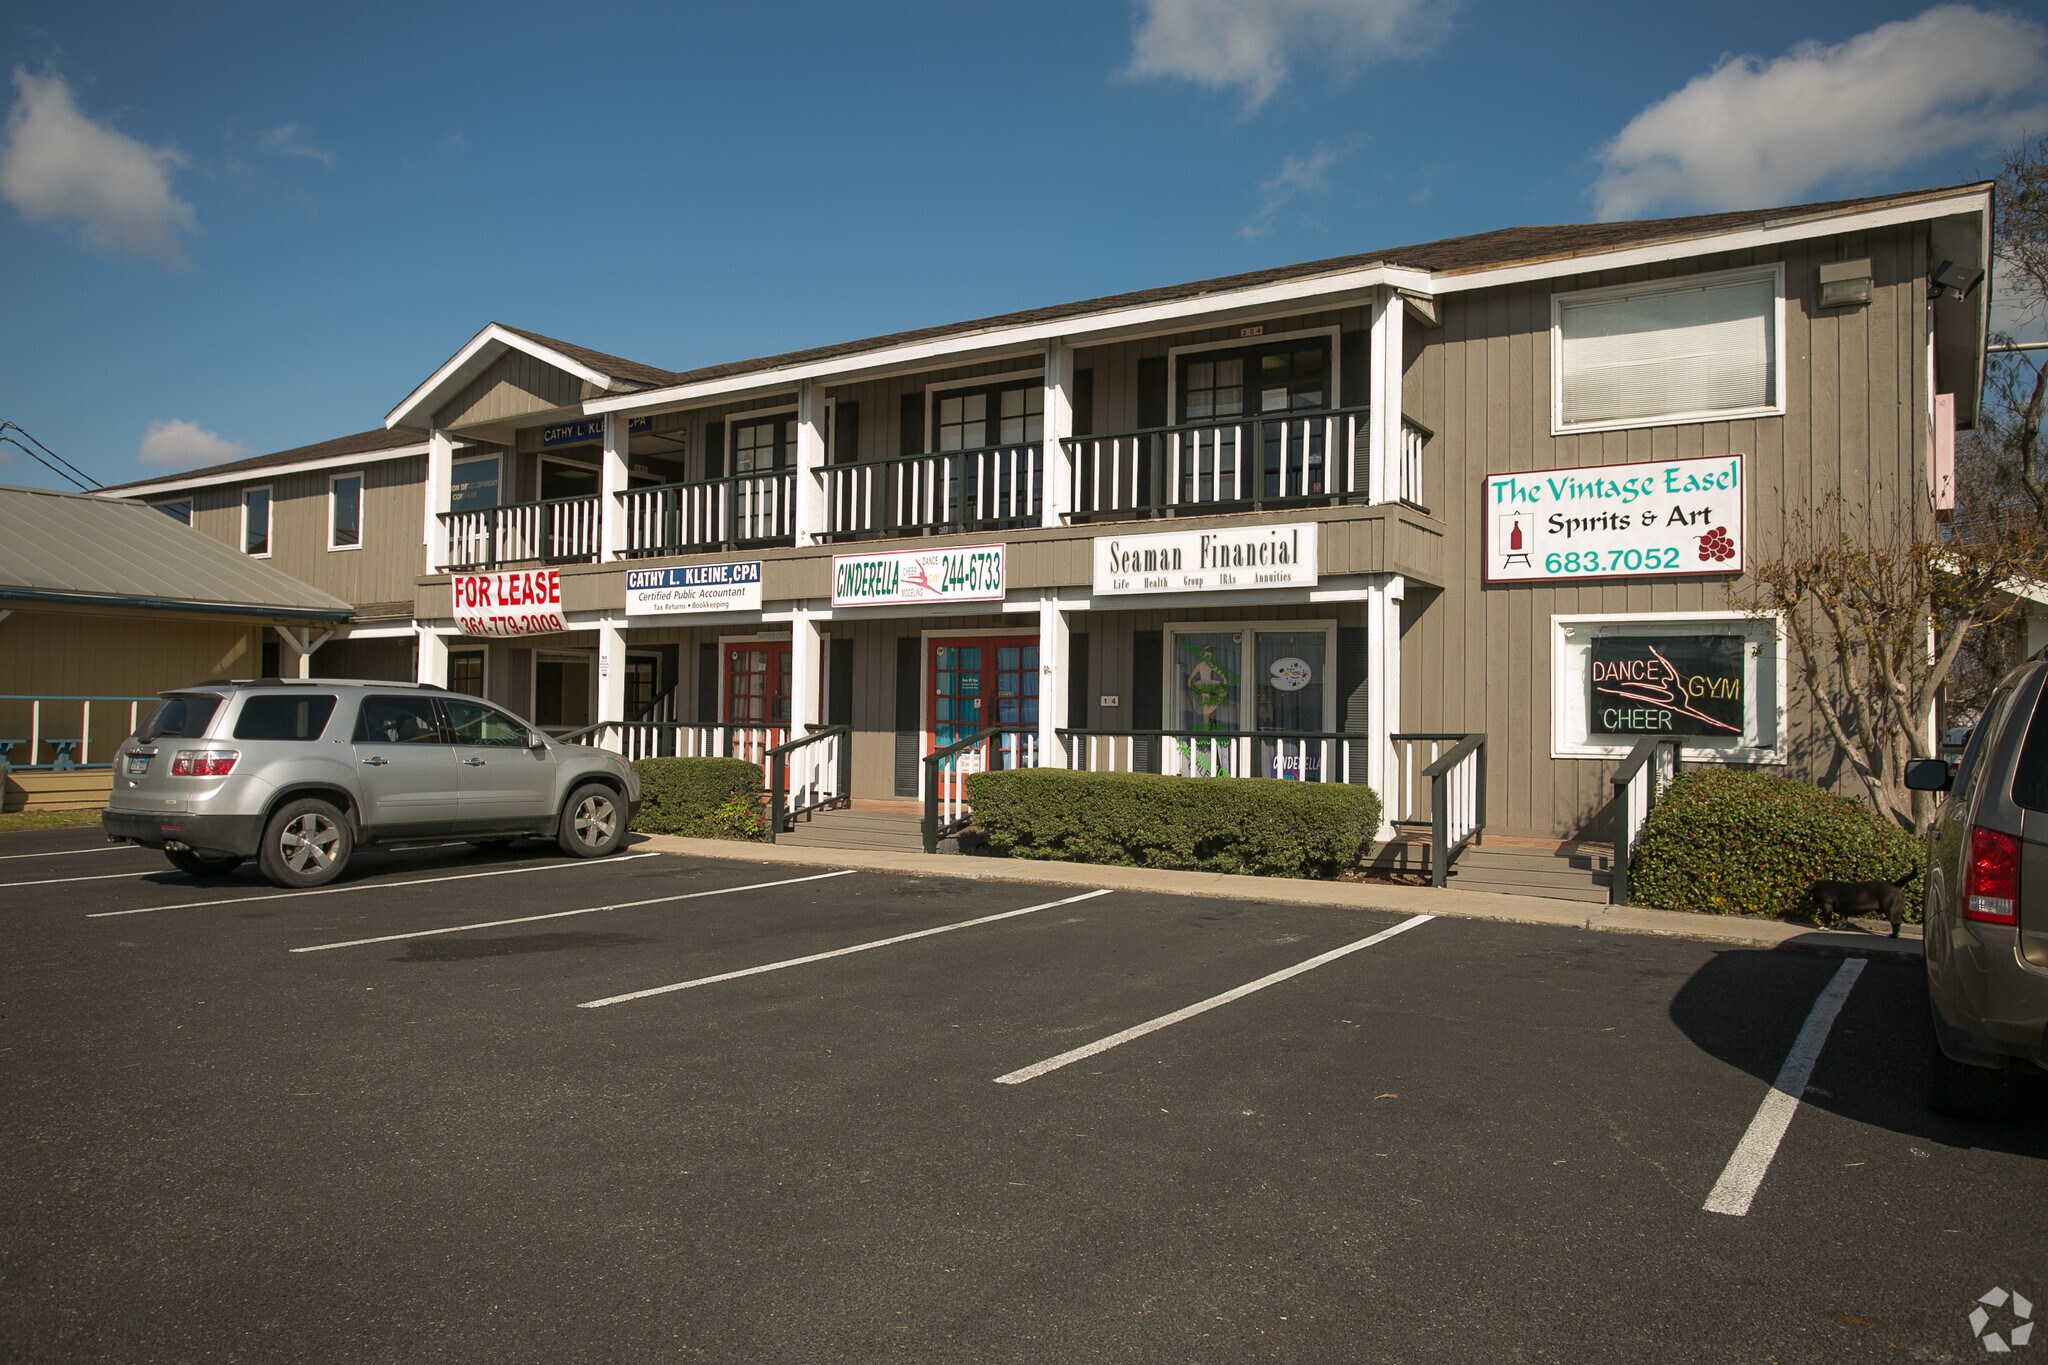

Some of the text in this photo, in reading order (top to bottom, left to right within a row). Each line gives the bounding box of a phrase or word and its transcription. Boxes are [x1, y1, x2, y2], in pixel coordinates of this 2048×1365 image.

[1242, 327, 1262, 336] 204
[544, 425, 573, 442] CATHY
[1490, 460, 1738, 505] The Vintage Easel
[1548, 505, 1713, 539] Spirits & Art
[922, 556, 939, 566] DANCE
[1109, 529, 1299, 574] Seaman Financial
[1545, 547, 1680, 574] 683.7052
[629, 570, 666, 588] CATHY
[669, 570, 680, 585] L.
[836, 560, 900, 598] CINDERELLA
[903, 567, 917, 576] CHEER
[928, 573, 940, 583] GYM
[941, 551, 1001, 593] 244-6733
[1113, 570, 1292, 589] Life Health Group IRAs Annuities
[455, 571, 560, 608] FOR LEASE
[638, 587, 746, 602] Certified Public Accountant
[901, 588, 924, 598] MODELING
[692, 601, 730, 609] Bookkeeping
[460, 613, 564, 636] 361-779-2009
[1593, 660, 1659, 681] DANCE
[1688, 675, 1740, 700] GYM
[1603, 708, 1673, 730] CHEER
[1272, 755, 1321, 770] CNDEELLA
